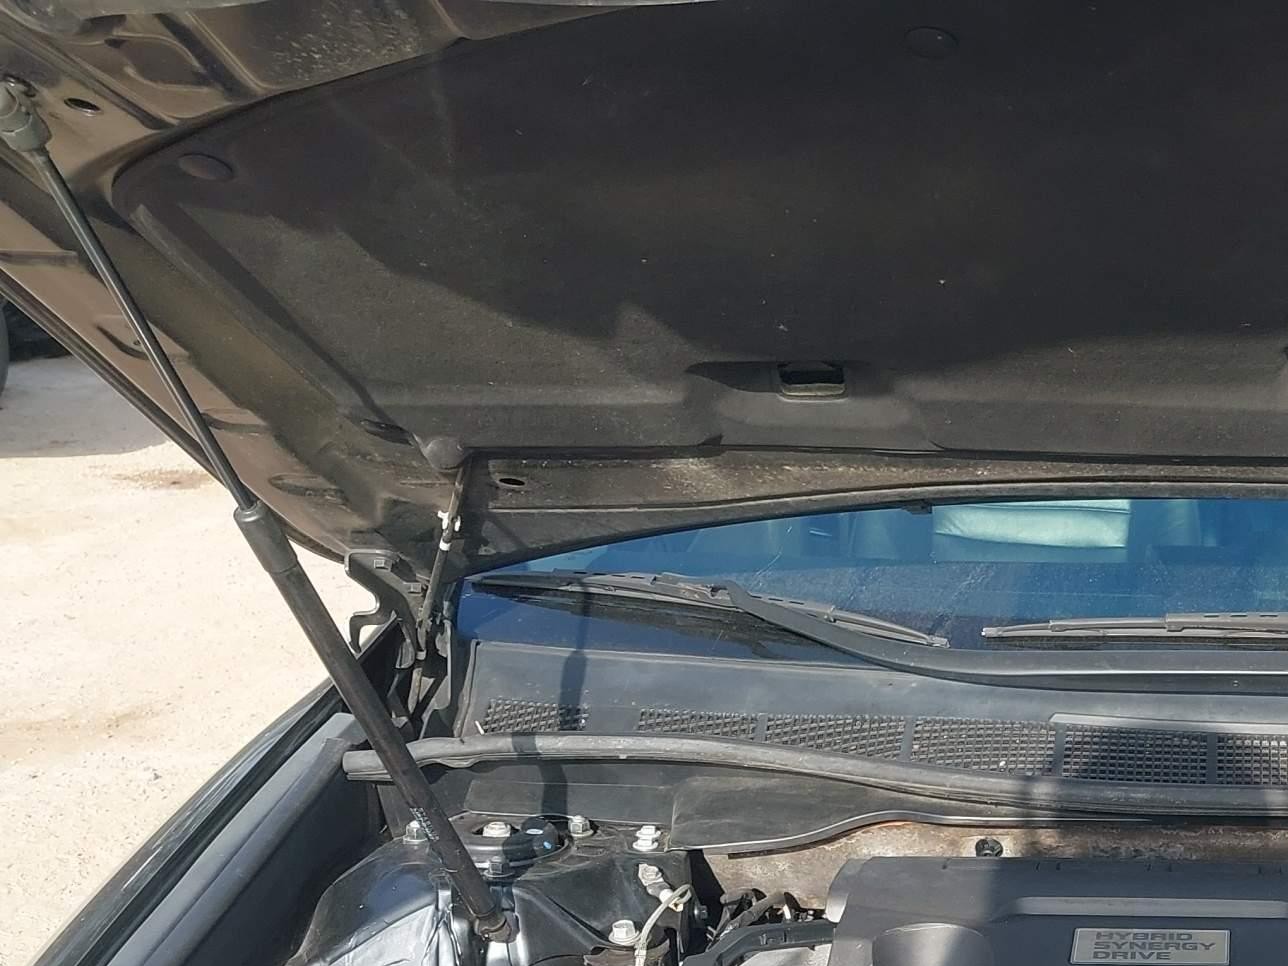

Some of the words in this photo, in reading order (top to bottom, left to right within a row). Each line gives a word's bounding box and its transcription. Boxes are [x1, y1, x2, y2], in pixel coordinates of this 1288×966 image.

[1096, 932, 1193, 941] HYBRID
[1094, 941, 1215, 950] SYNERGY
[1092, 950, 1172, 960] DRIVE
